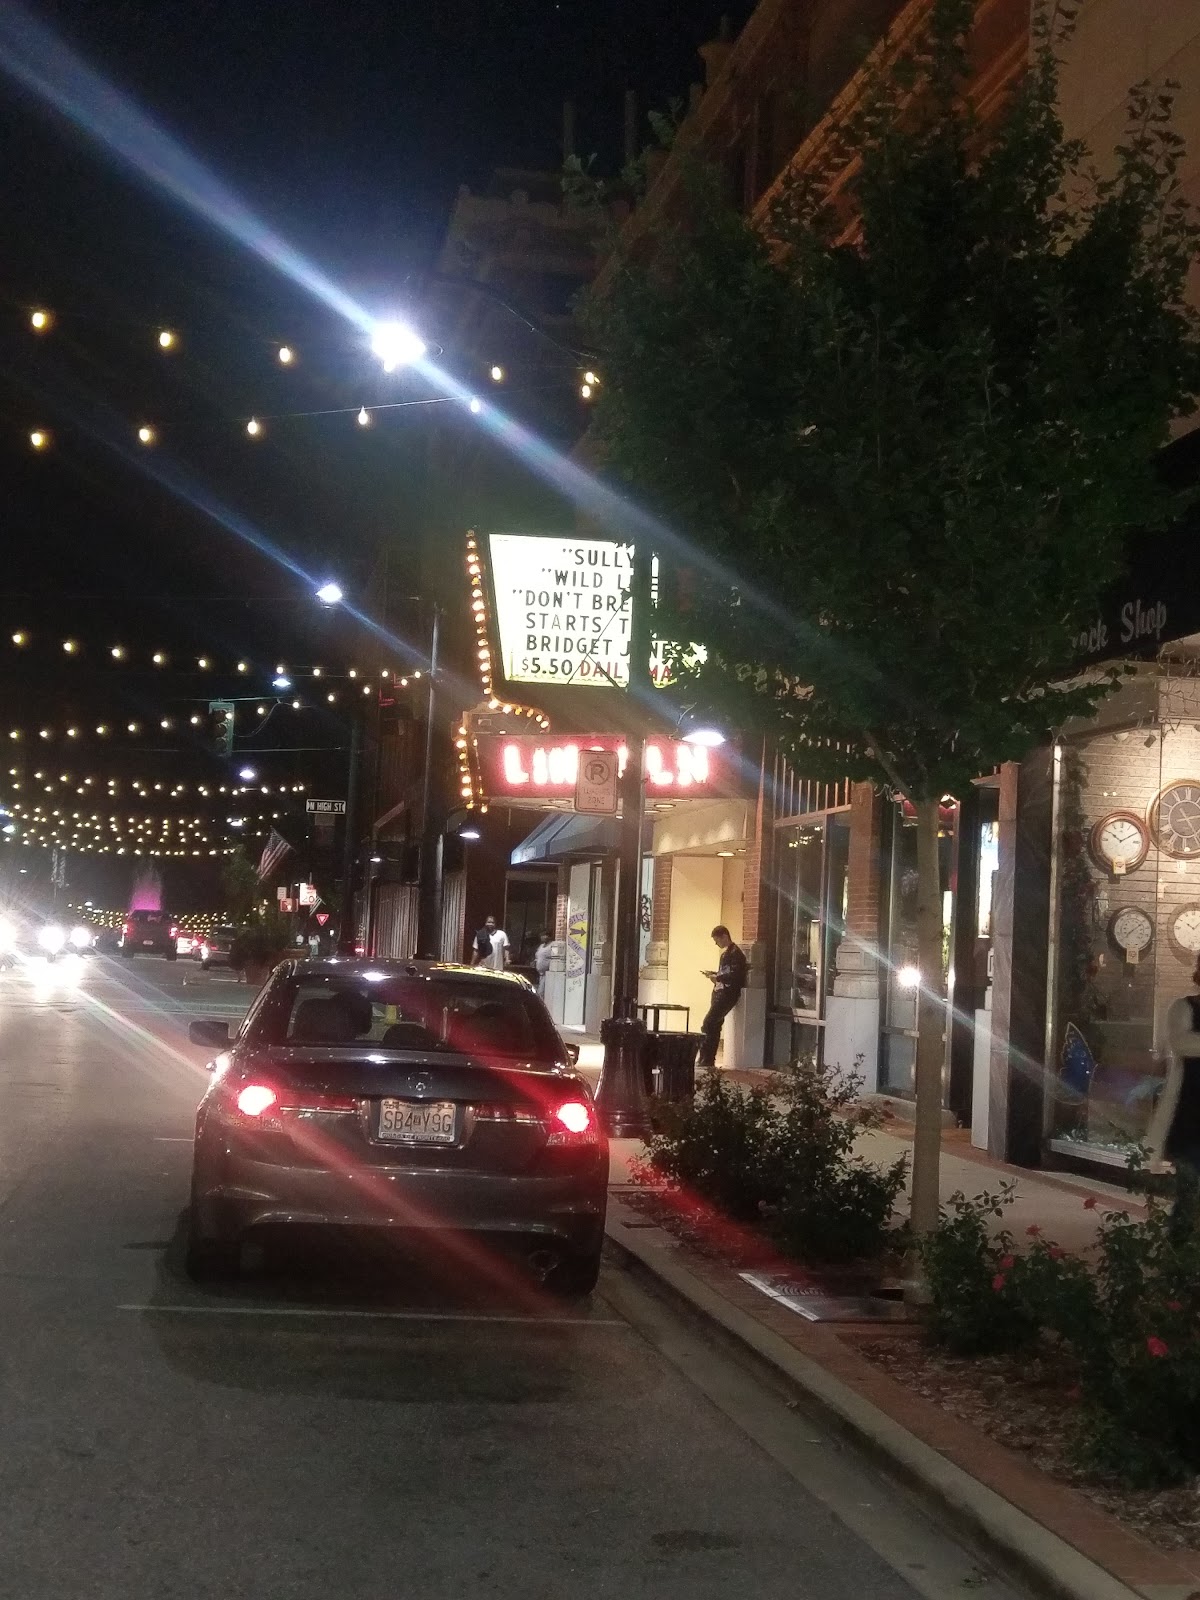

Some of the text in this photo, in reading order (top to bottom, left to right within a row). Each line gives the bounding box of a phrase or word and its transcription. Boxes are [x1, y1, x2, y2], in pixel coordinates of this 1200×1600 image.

[592, 594, 629, 612] BRE
[526, 612, 602, 633] STARTS
[1121, 599, 1167, 643] Shop
[526, 634, 612, 656] BRIDGET
[521, 657, 573, 676] $5.50
[580, 661, 631, 679] DAIL
[316, 801, 332, 812] HIGH
[334, 802, 343, 812] ST
